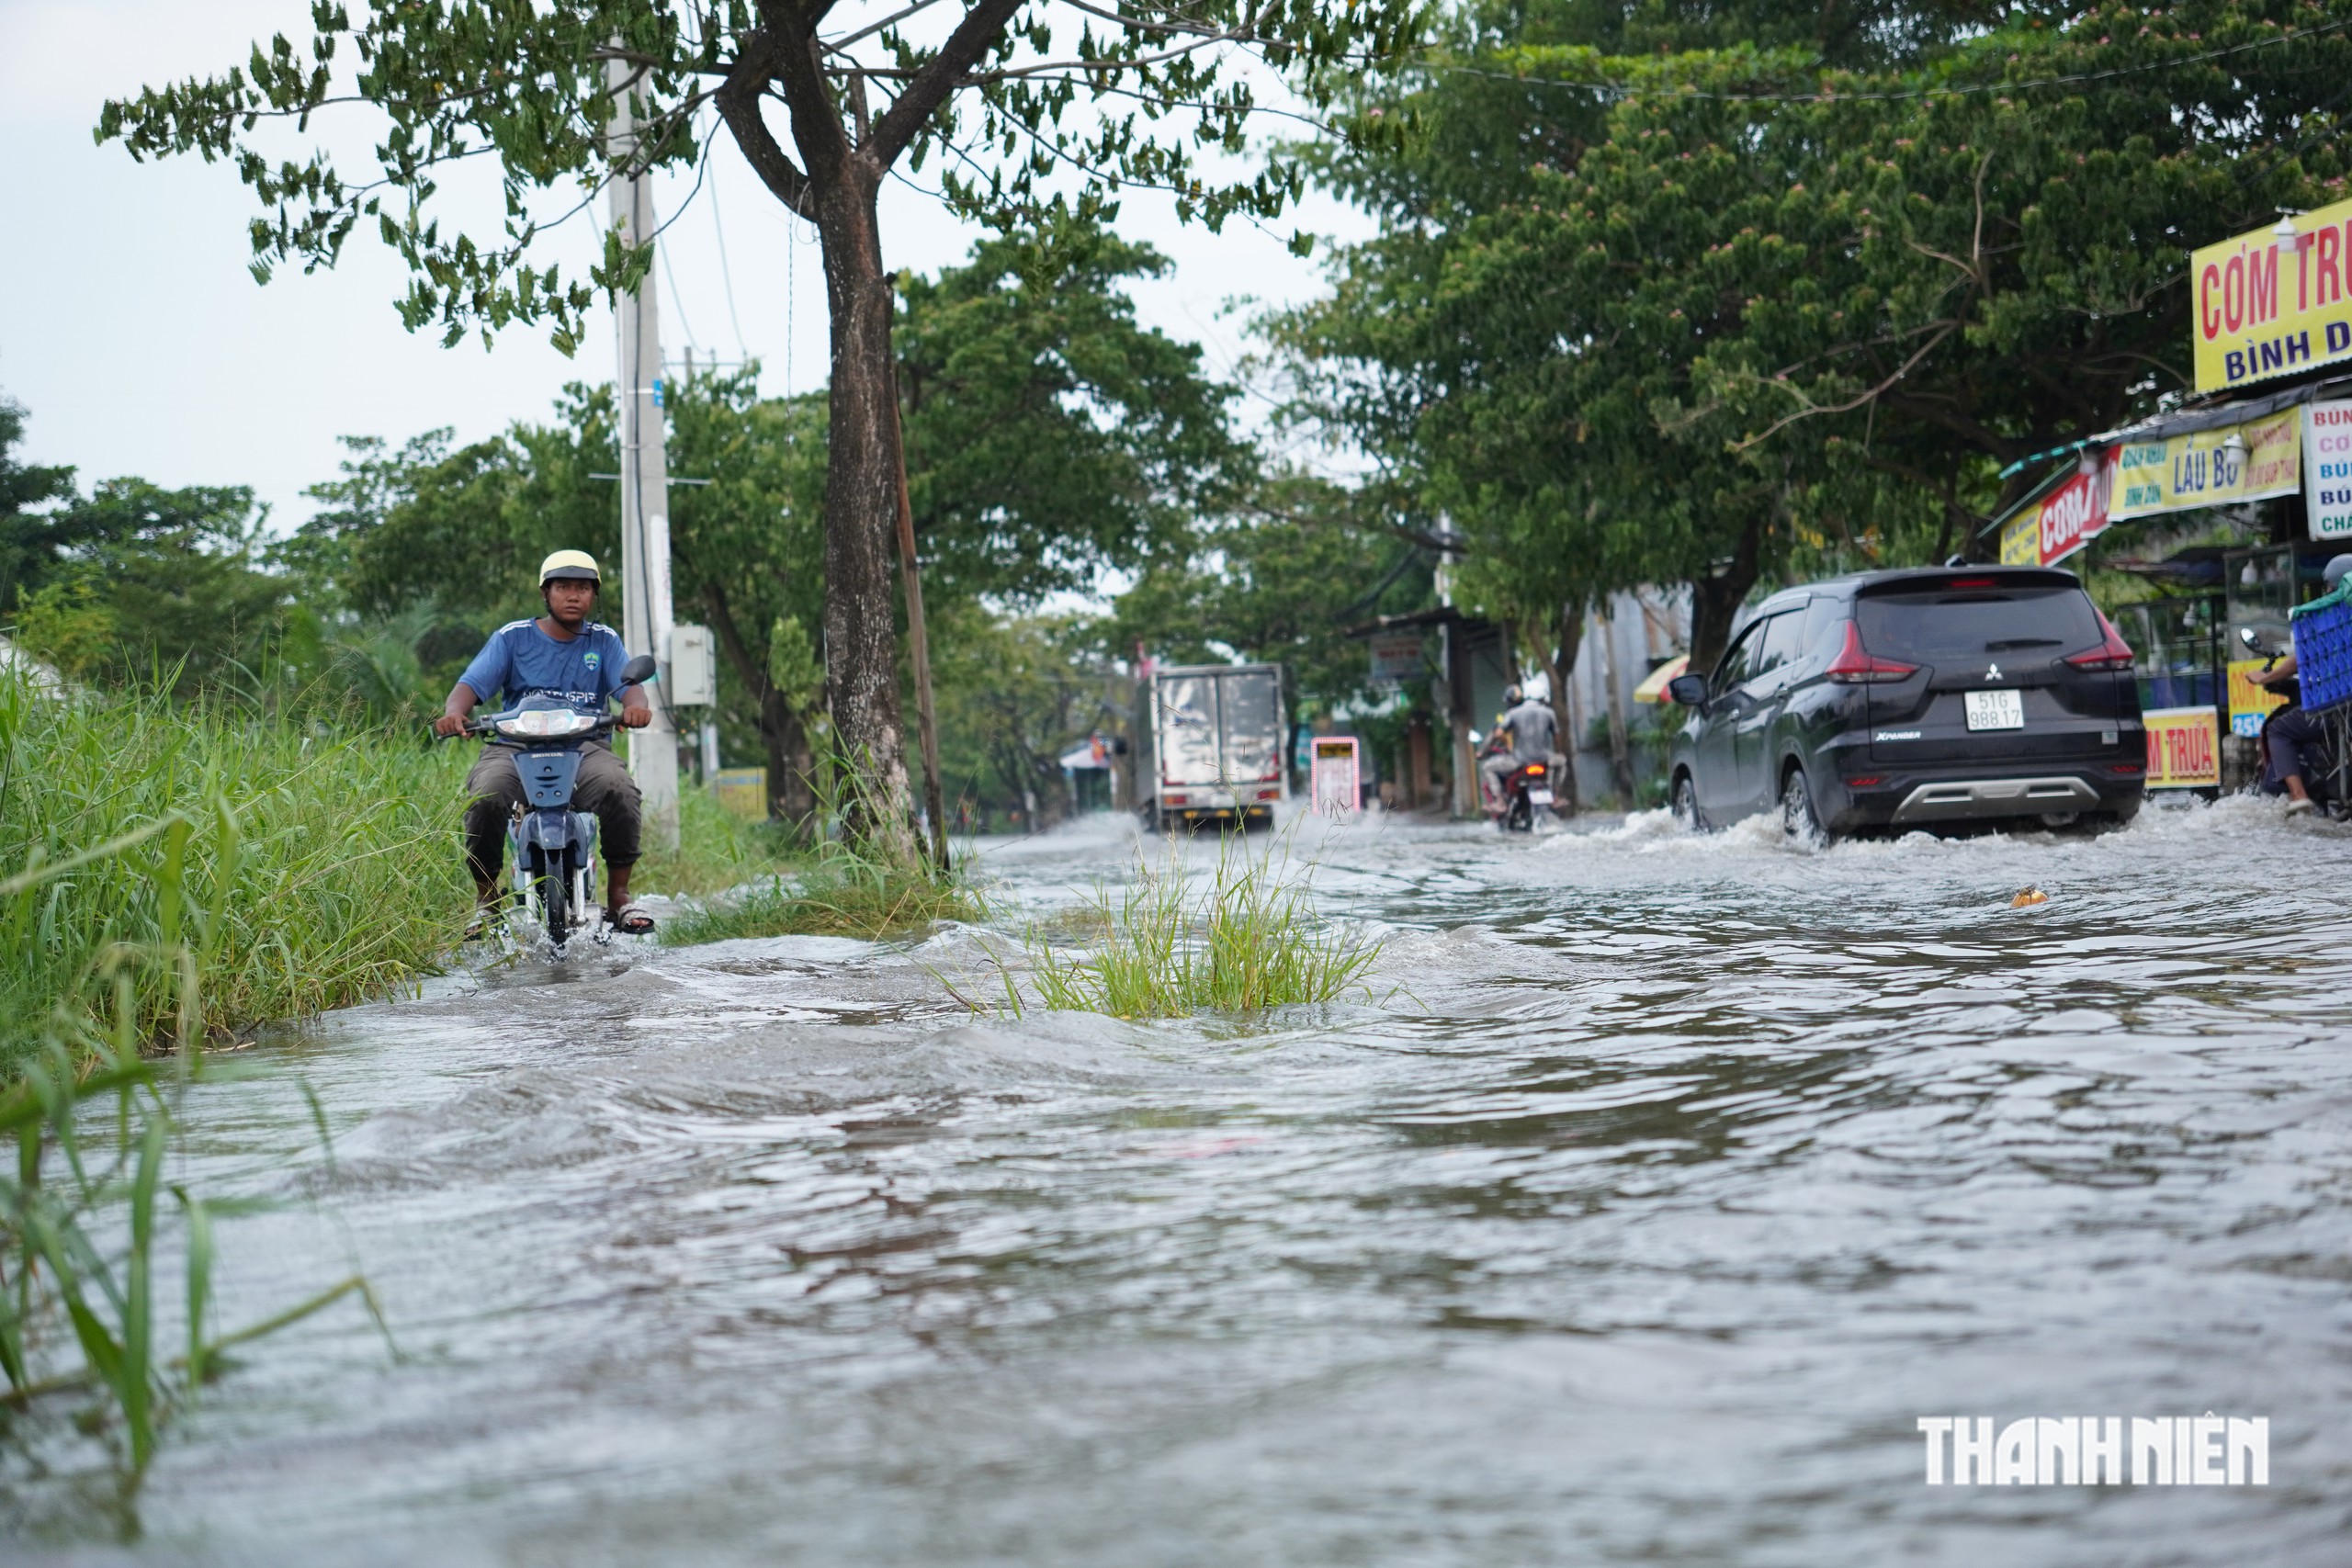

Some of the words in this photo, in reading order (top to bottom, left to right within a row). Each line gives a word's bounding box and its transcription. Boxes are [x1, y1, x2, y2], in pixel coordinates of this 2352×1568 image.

[2200, 243, 2278, 342] CƠM
[2225, 330, 2311, 383] BÌNH
[2313, 407, 2352, 427] BÚN
[2320, 458, 2352, 479] BÚ
[1978, 693, 2008, 710] 51G
[1969, 709, 2020, 728] 988.17
[1875, 731, 1922, 741] XPANDER
[2166, 720, 2215, 775] TRƯA
